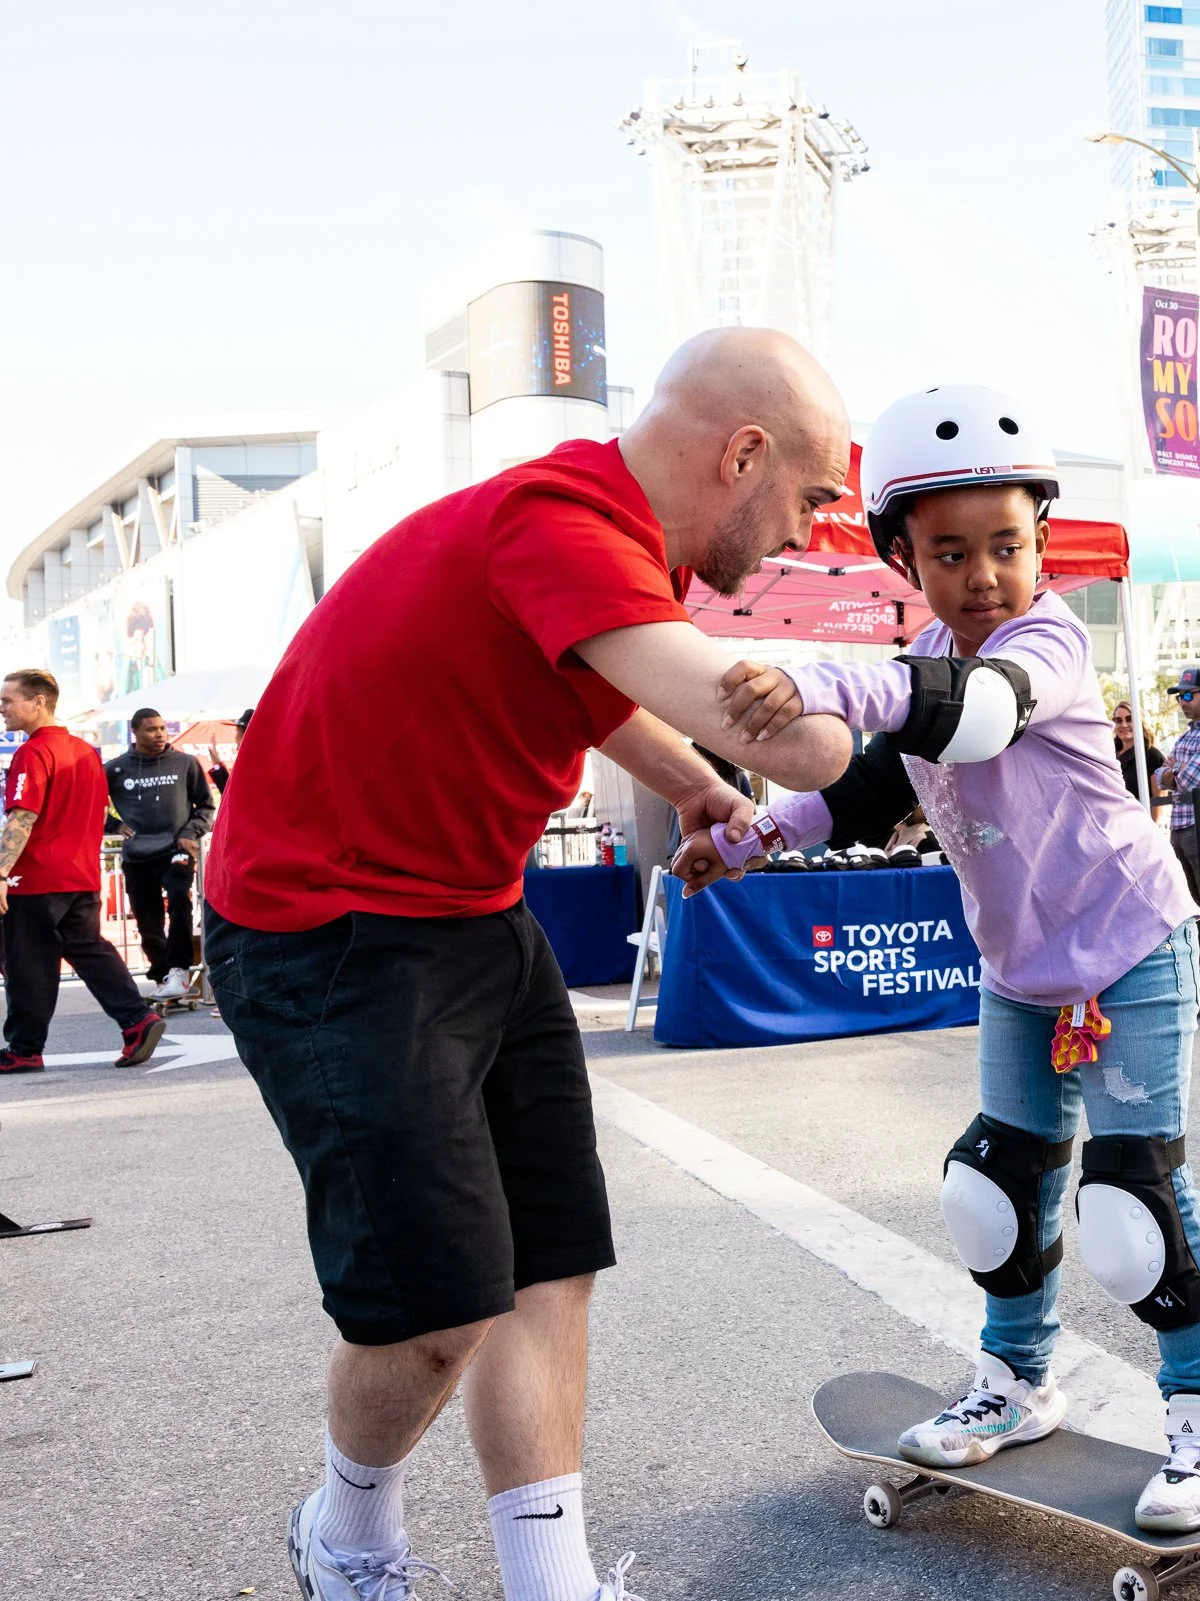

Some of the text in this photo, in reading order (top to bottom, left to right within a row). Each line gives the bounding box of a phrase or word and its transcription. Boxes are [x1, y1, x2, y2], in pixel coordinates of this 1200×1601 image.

[1155, 299, 1179, 310] Oct 30
[552, 292, 572, 386] TOSHIBA
[1153, 359, 1192, 396] MY
[842, 919, 954, 947] TOYOTA
[813, 946, 917, 973] SPORTS
[862, 966, 980, 996] FESTIVAL
